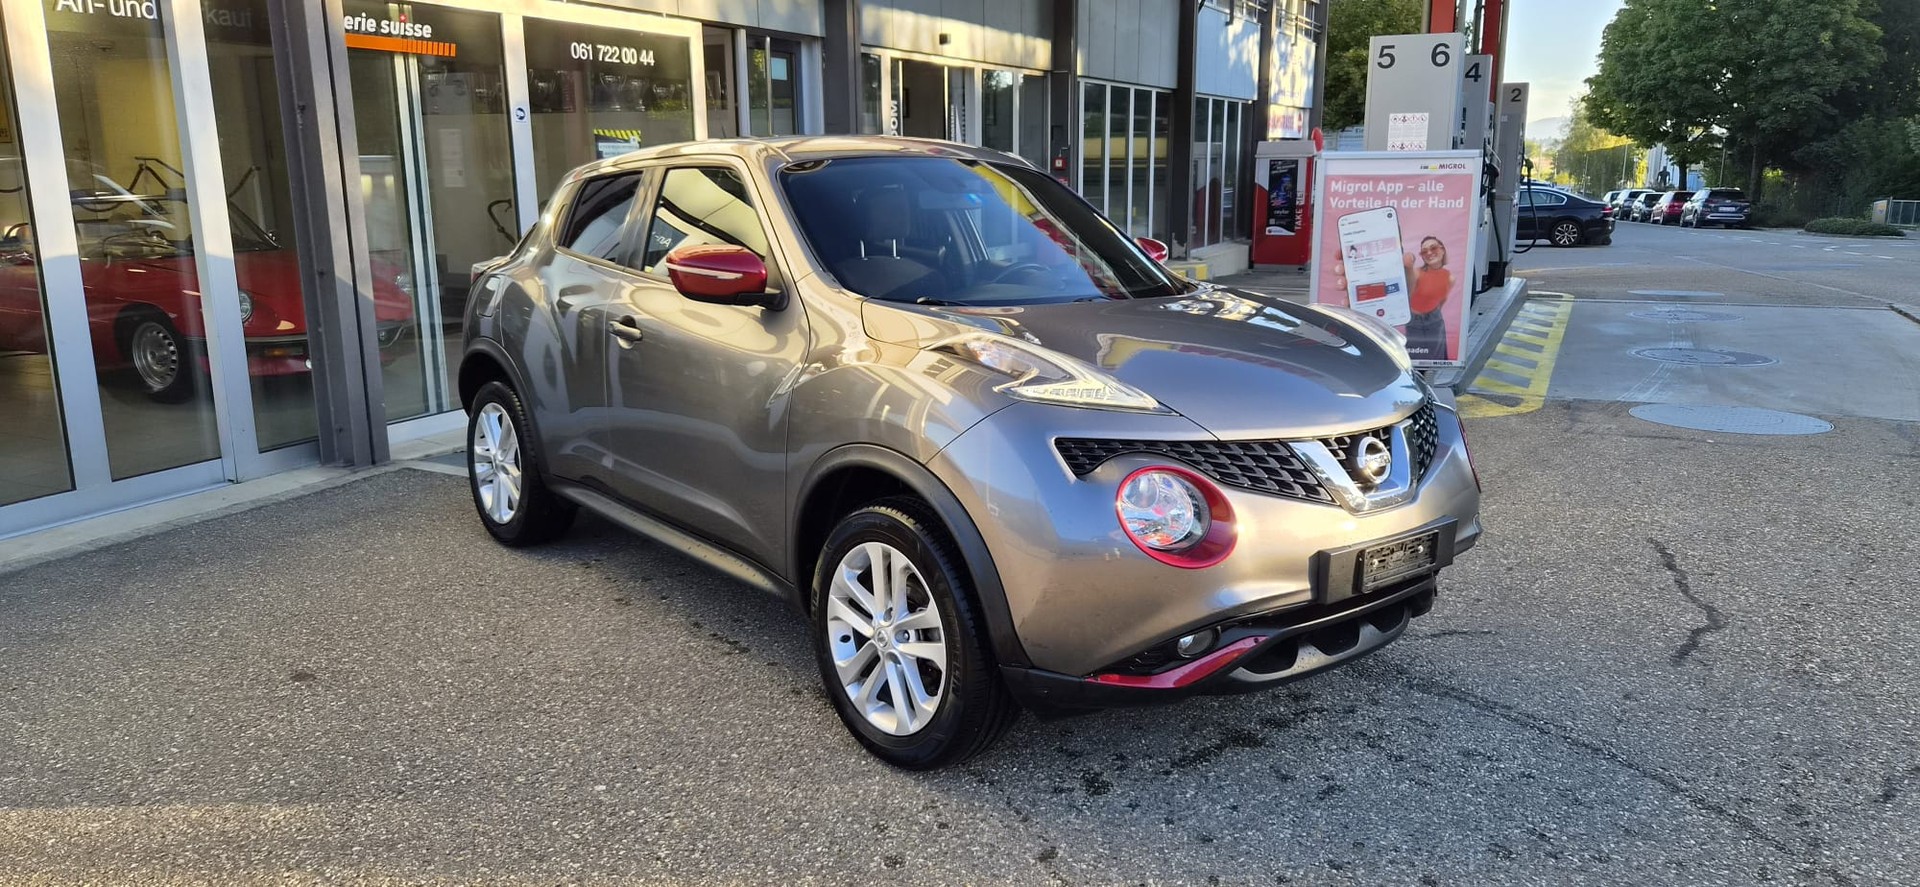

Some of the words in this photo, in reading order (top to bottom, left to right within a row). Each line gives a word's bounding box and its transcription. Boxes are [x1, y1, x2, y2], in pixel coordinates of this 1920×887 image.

[108, 0, 158, 19] und
[344, 12, 377, 32] erie
[380, 17, 432, 38] suisse
[570, 42, 593, 60] 061
[596, 44, 620, 63] 722
[621, 47, 637, 64] 00
[639, 49, 655, 66] 44
[1377, 45, 1396, 69] 5
[1430, 43, 1450, 67] 6
[1464, 62, 1482, 82] 4
[1510, 88, 1522, 102] 2
[1331, 180, 1373, 195] Migrol
[1377, 180, 1403, 195] App
[1418, 180, 1445, 192] alle
[1330, 196, 1382, 208] Vorteile
[1385, 196, 1398, 208] in
[1401, 196, 1425, 208] der
[1428, 196, 1464, 208] Hand
[1294, 208, 1303, 230] TAKE
